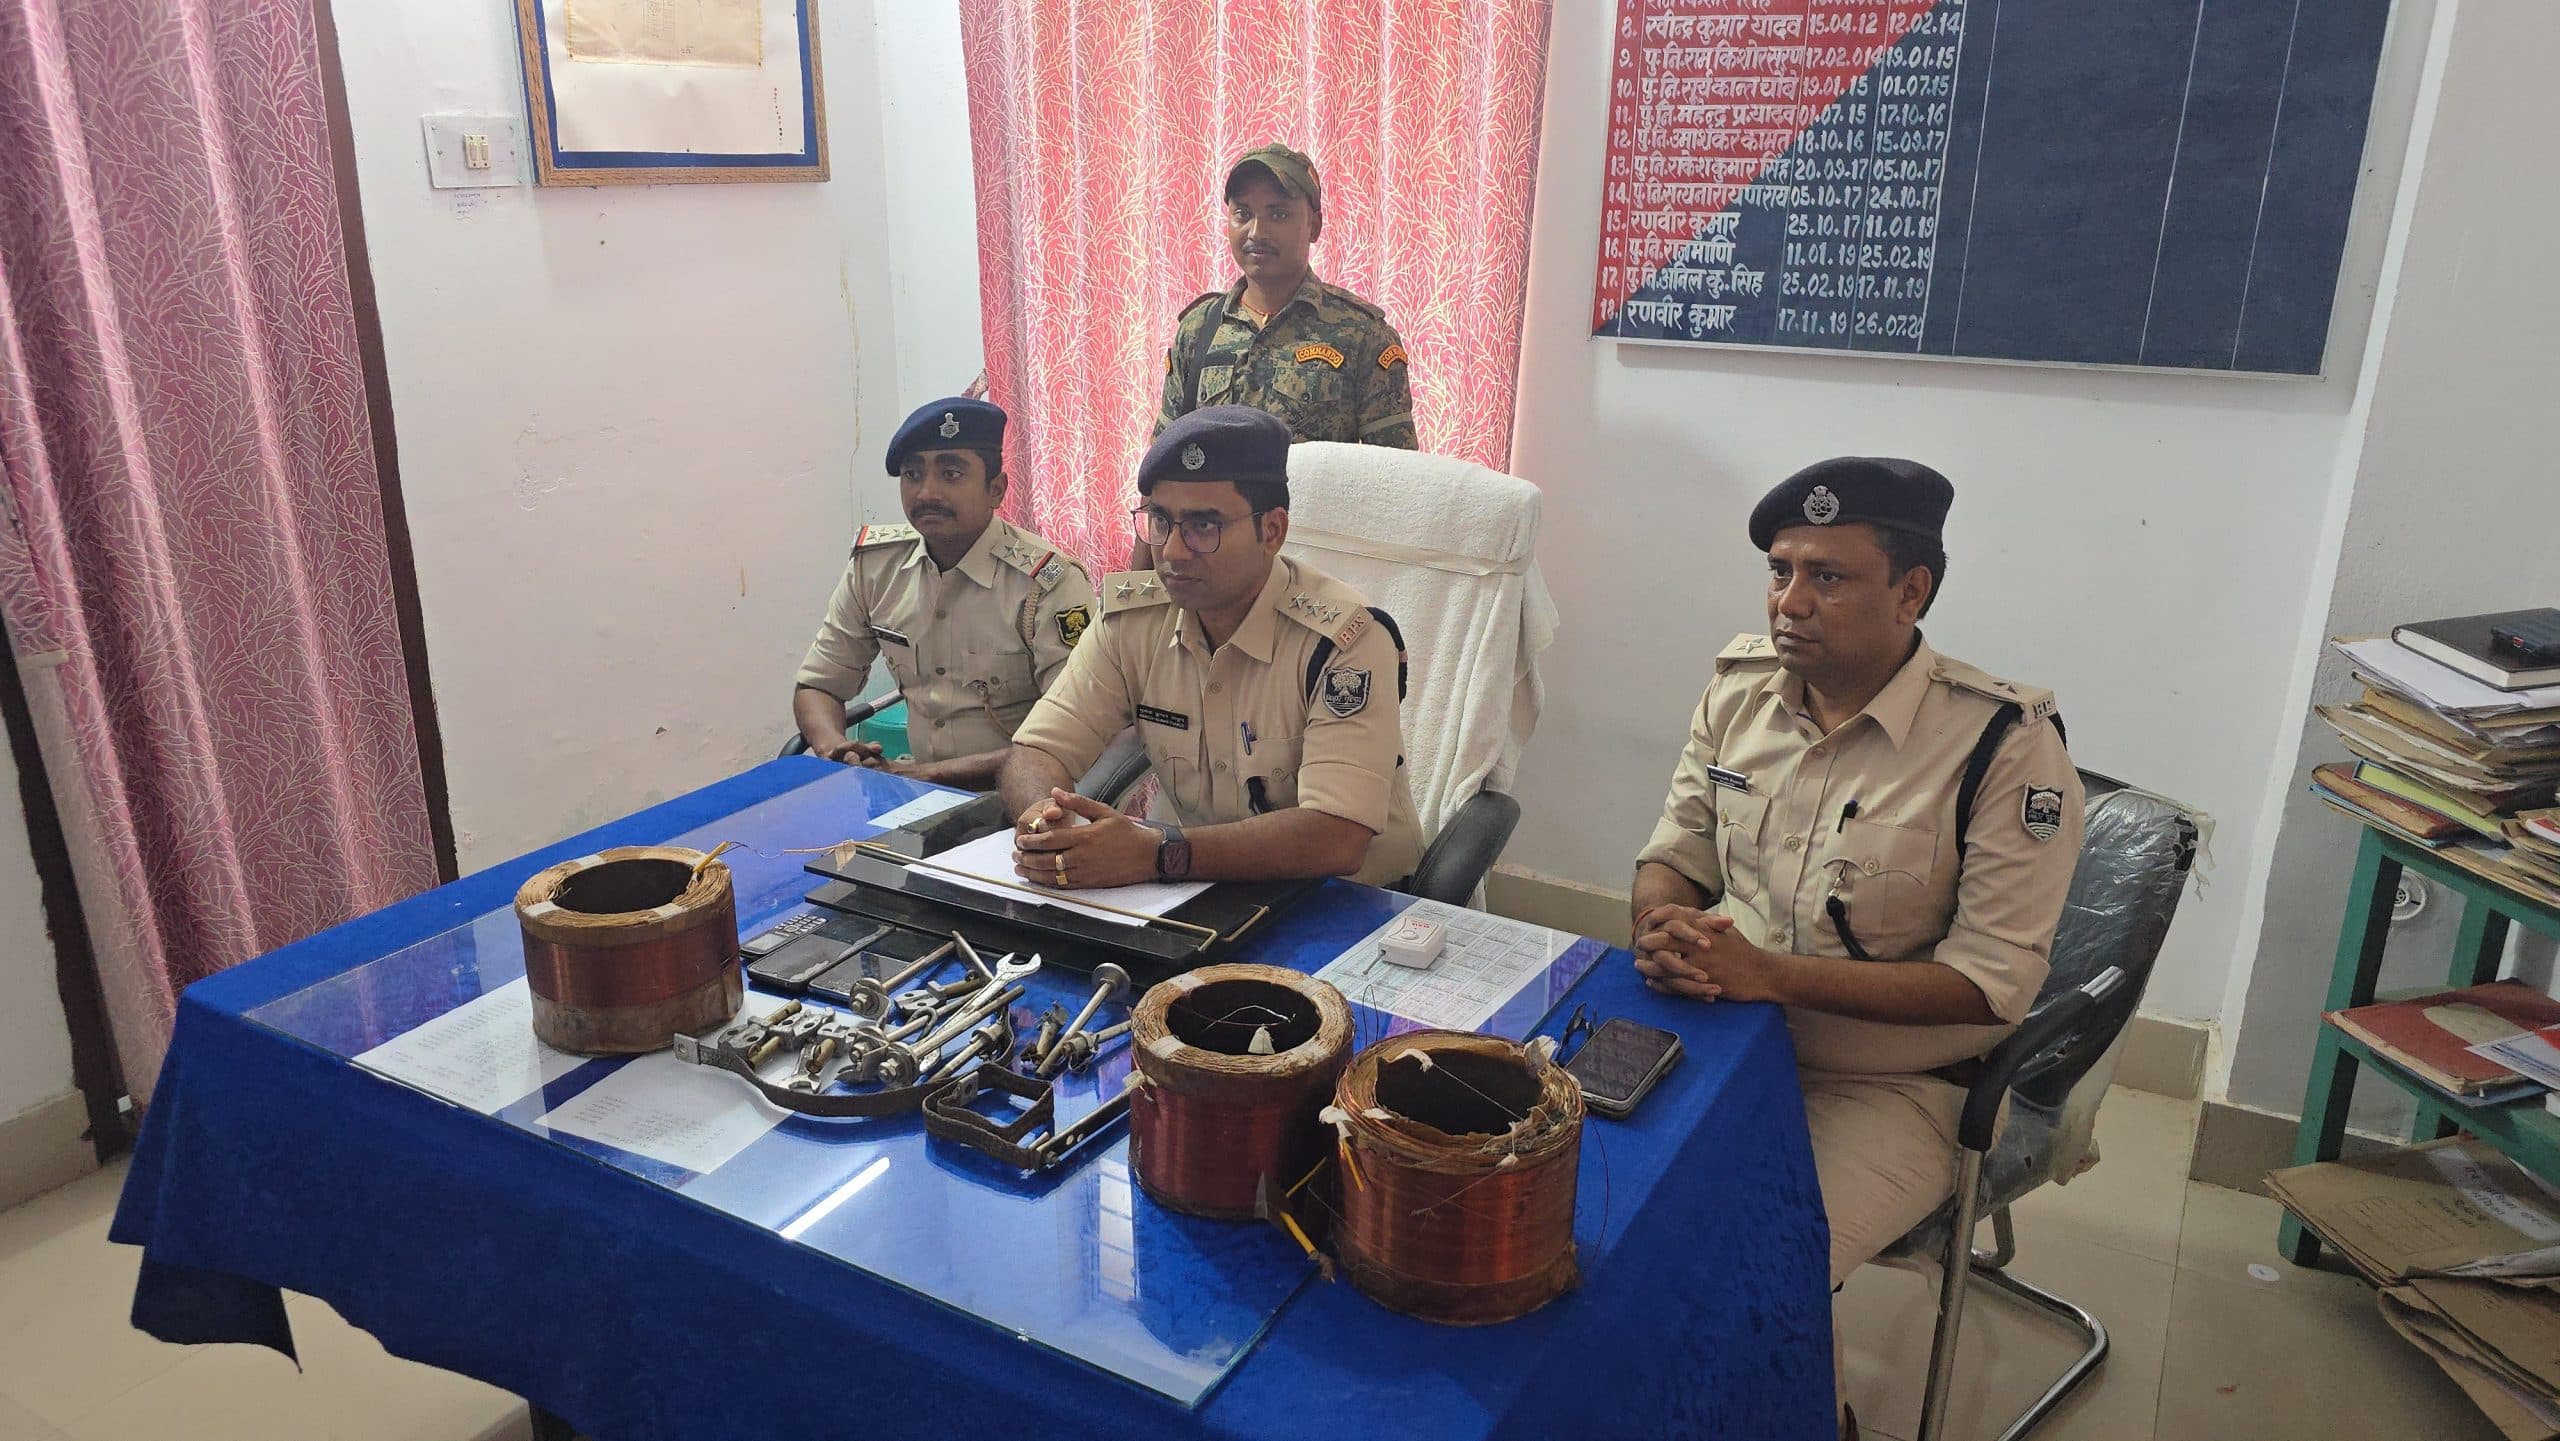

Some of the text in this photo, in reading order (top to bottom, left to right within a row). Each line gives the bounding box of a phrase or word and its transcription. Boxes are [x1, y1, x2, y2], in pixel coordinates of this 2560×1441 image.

[1697, 15, 1749, 45] कुमार
[1751, 15, 1803, 40] यादव
[1810, 13, 1877, 35] 15.04.12
[1889, 12, 1961, 36] 12.02.14
[1886, 46, 1955, 70] 19.01.15
[1881, 103, 1946, 127] 17.10.16
[1797, 129, 1864, 154] 18.10.16
[1876, 129, 1945, 153] 15.09.17
[1794, 158, 1869, 181] 20.09.17
[1873, 158, 1941, 181] 05.10.17
[1791, 185, 1862, 210] 05.10.17
[1869, 185, 1938, 211] 24.10.17
[1631, 205, 1687, 234] रणवीर
[1689, 211, 1741, 239] कुमार
[1788, 214, 1861, 238] 25.10.17
[1866, 214, 1934, 238] 11.01.19
[1860, 244, 1931, 269] 25.02.19
[1782, 272, 1854, 298] 25.02.19
[1858, 275, 1925, 300] 17.11.19
[1627, 295, 1683, 330] रणवीर
[1689, 304, 1737, 337] कुमार
[1779, 308, 1847, 335] 17.11.19
[1299, 347, 1340, 363] COMMANDO
